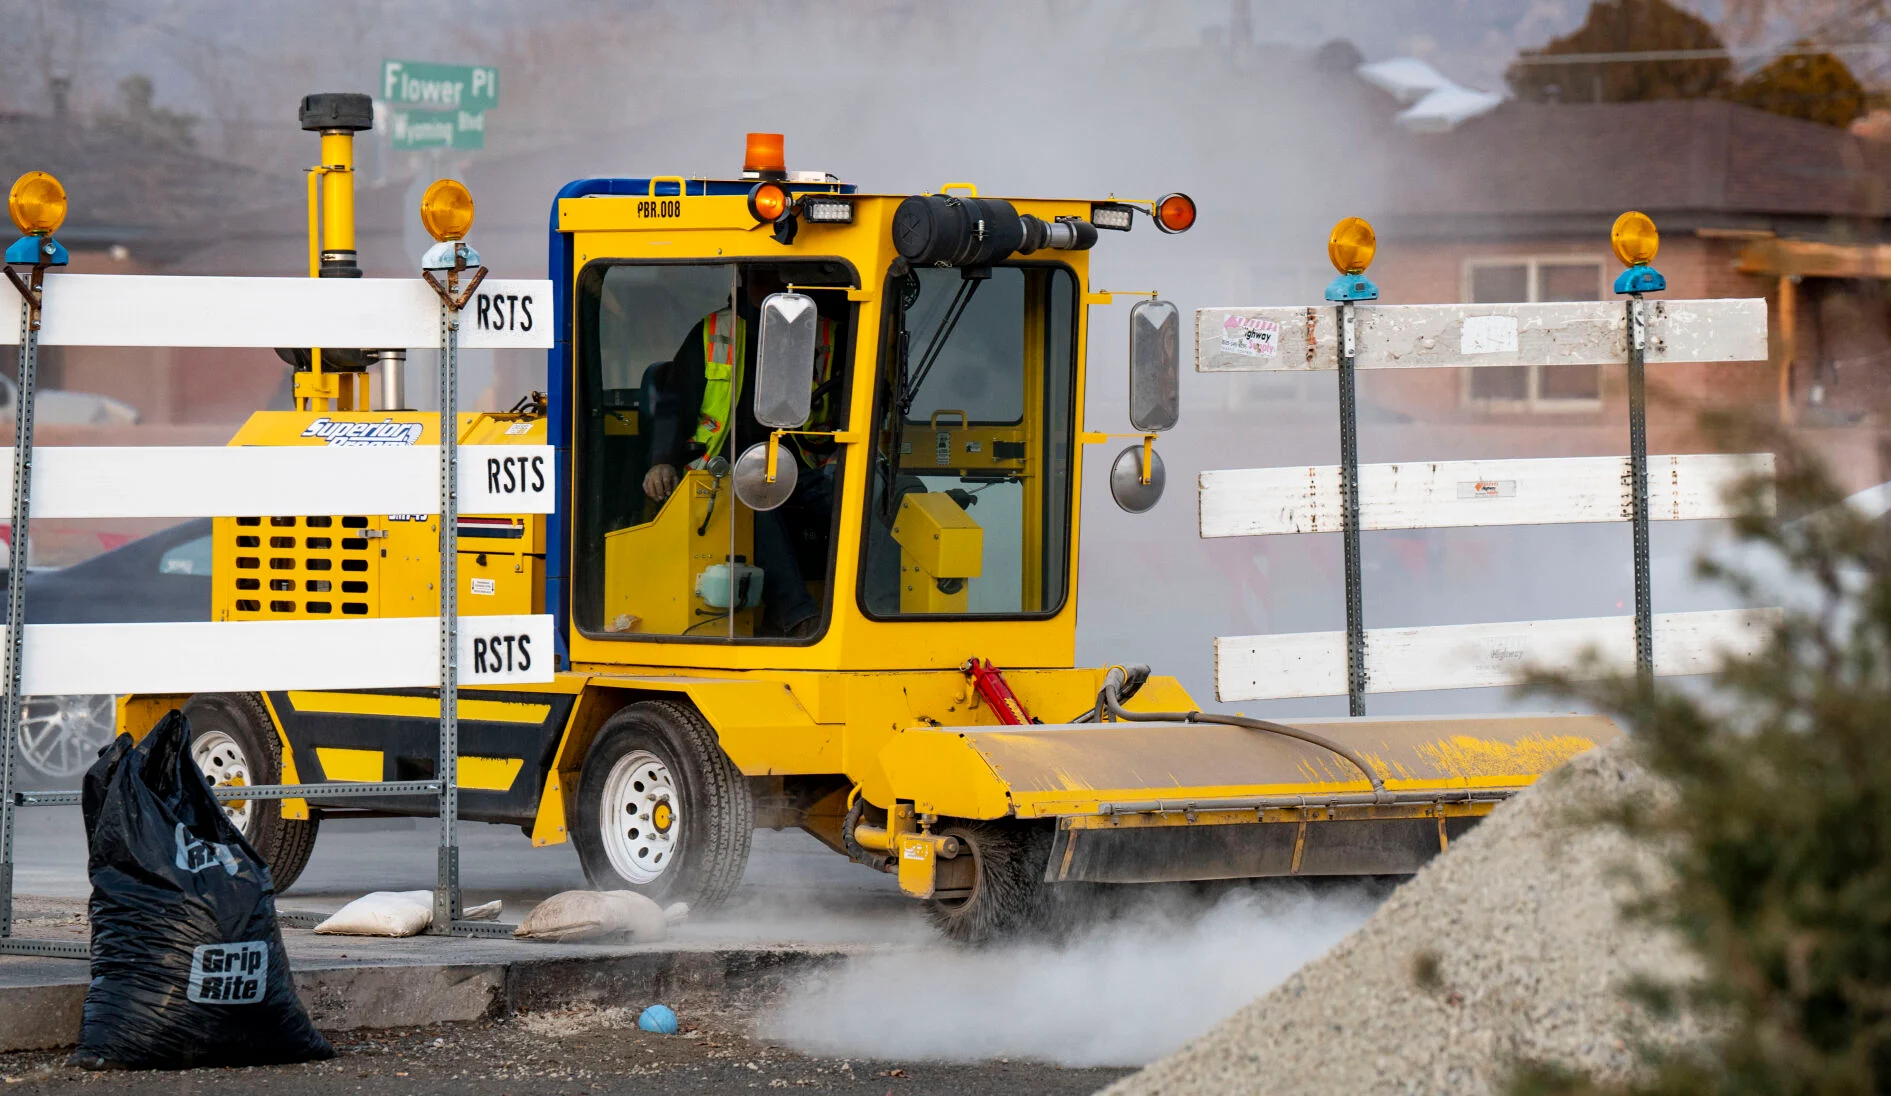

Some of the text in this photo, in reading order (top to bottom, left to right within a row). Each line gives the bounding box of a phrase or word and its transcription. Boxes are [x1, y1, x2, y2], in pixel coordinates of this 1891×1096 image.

[384, 63, 495, 104] Flower Pl
[637, 200, 681, 218] PBR.008
[477, 293, 533, 331] RSTS
[300, 418, 411, 440] Superior
[487, 456, 545, 494] RSTS
[474, 634, 531, 673] RSTS
[202, 947, 262, 976] Grip
[200, 975, 259, 1000] Rite
